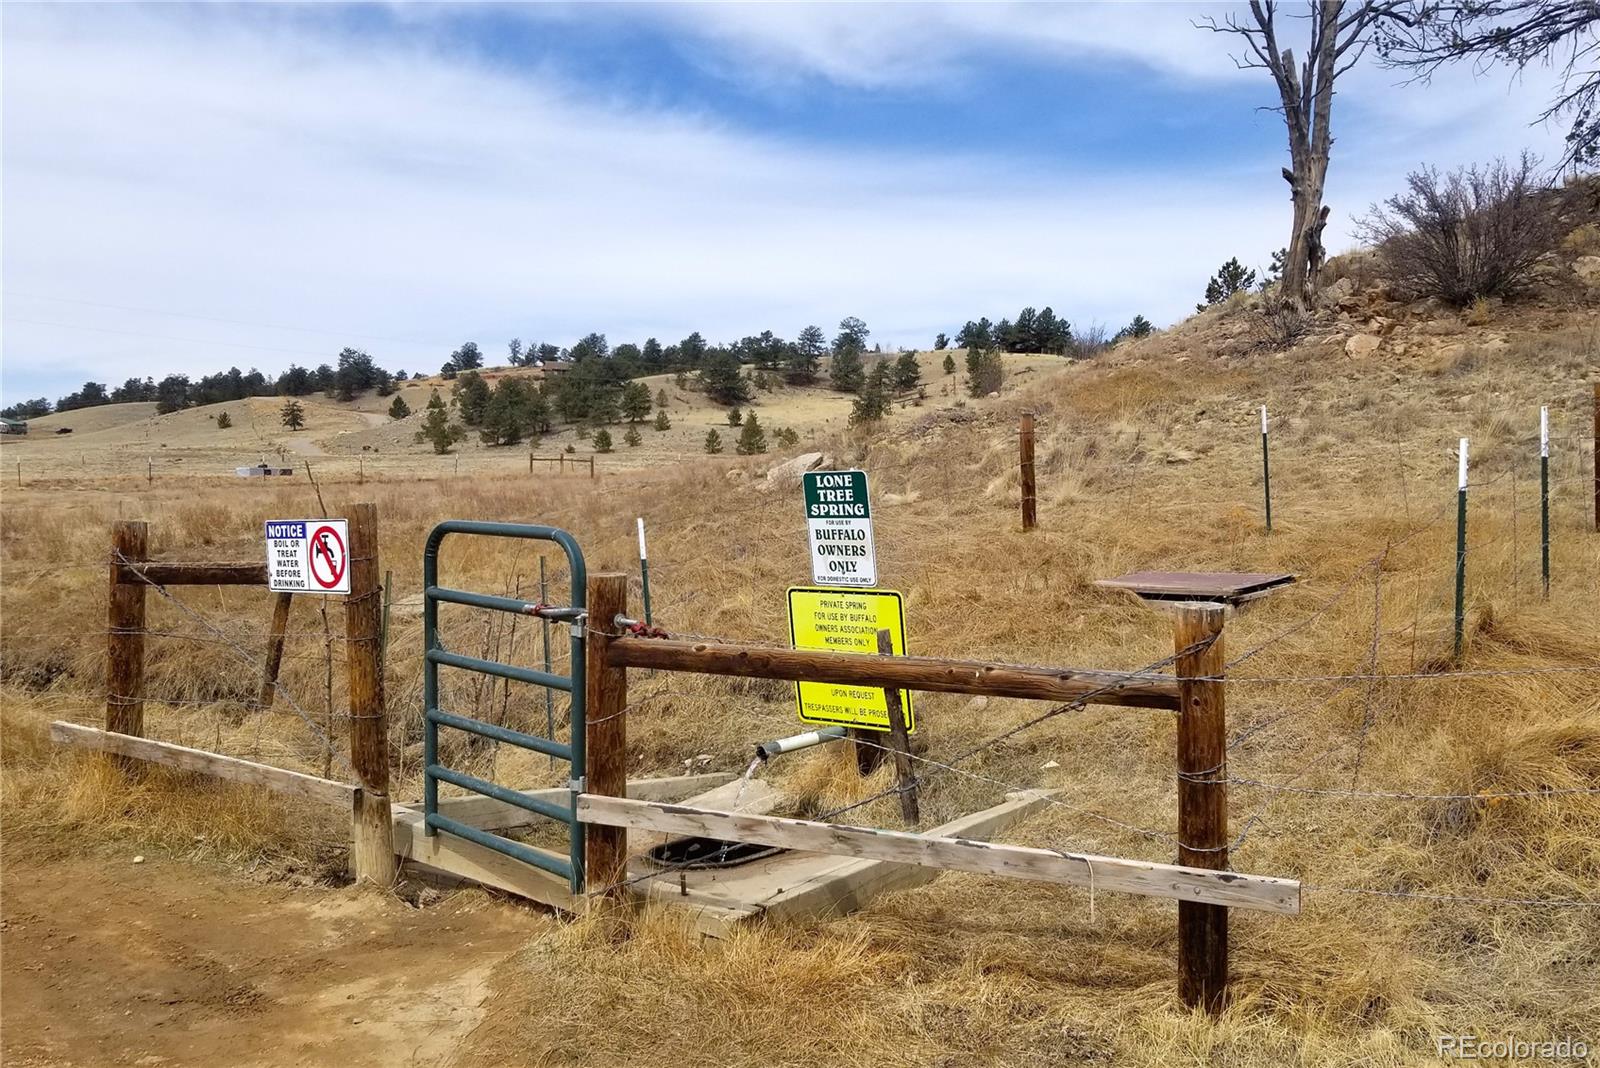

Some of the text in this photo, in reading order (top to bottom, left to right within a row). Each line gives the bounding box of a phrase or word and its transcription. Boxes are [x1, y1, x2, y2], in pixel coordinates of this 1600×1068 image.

[816, 474, 852, 488] LONE
[817, 489, 854, 502] TREE
[811, 504, 864, 516] SPRING
[268, 525, 303, 538] NOTICE
[815, 529, 866, 540] BUFFALO
[818, 544, 866, 556] OWNERS
[829, 561, 857, 572] ONLY
[820, 600, 867, 610] PRIVATE SPRING
[814, 612, 877, 623] FOR USE BY BUFFALO
[815, 624, 878, 635] OWNERS ASSOCIATION
[825, 636, 870, 646] MEMBERS ONLY
[831, 689, 875, 700] UPON REQUEST
[804, 703, 888, 718] TRESPASSERS WILL BE PROSE
